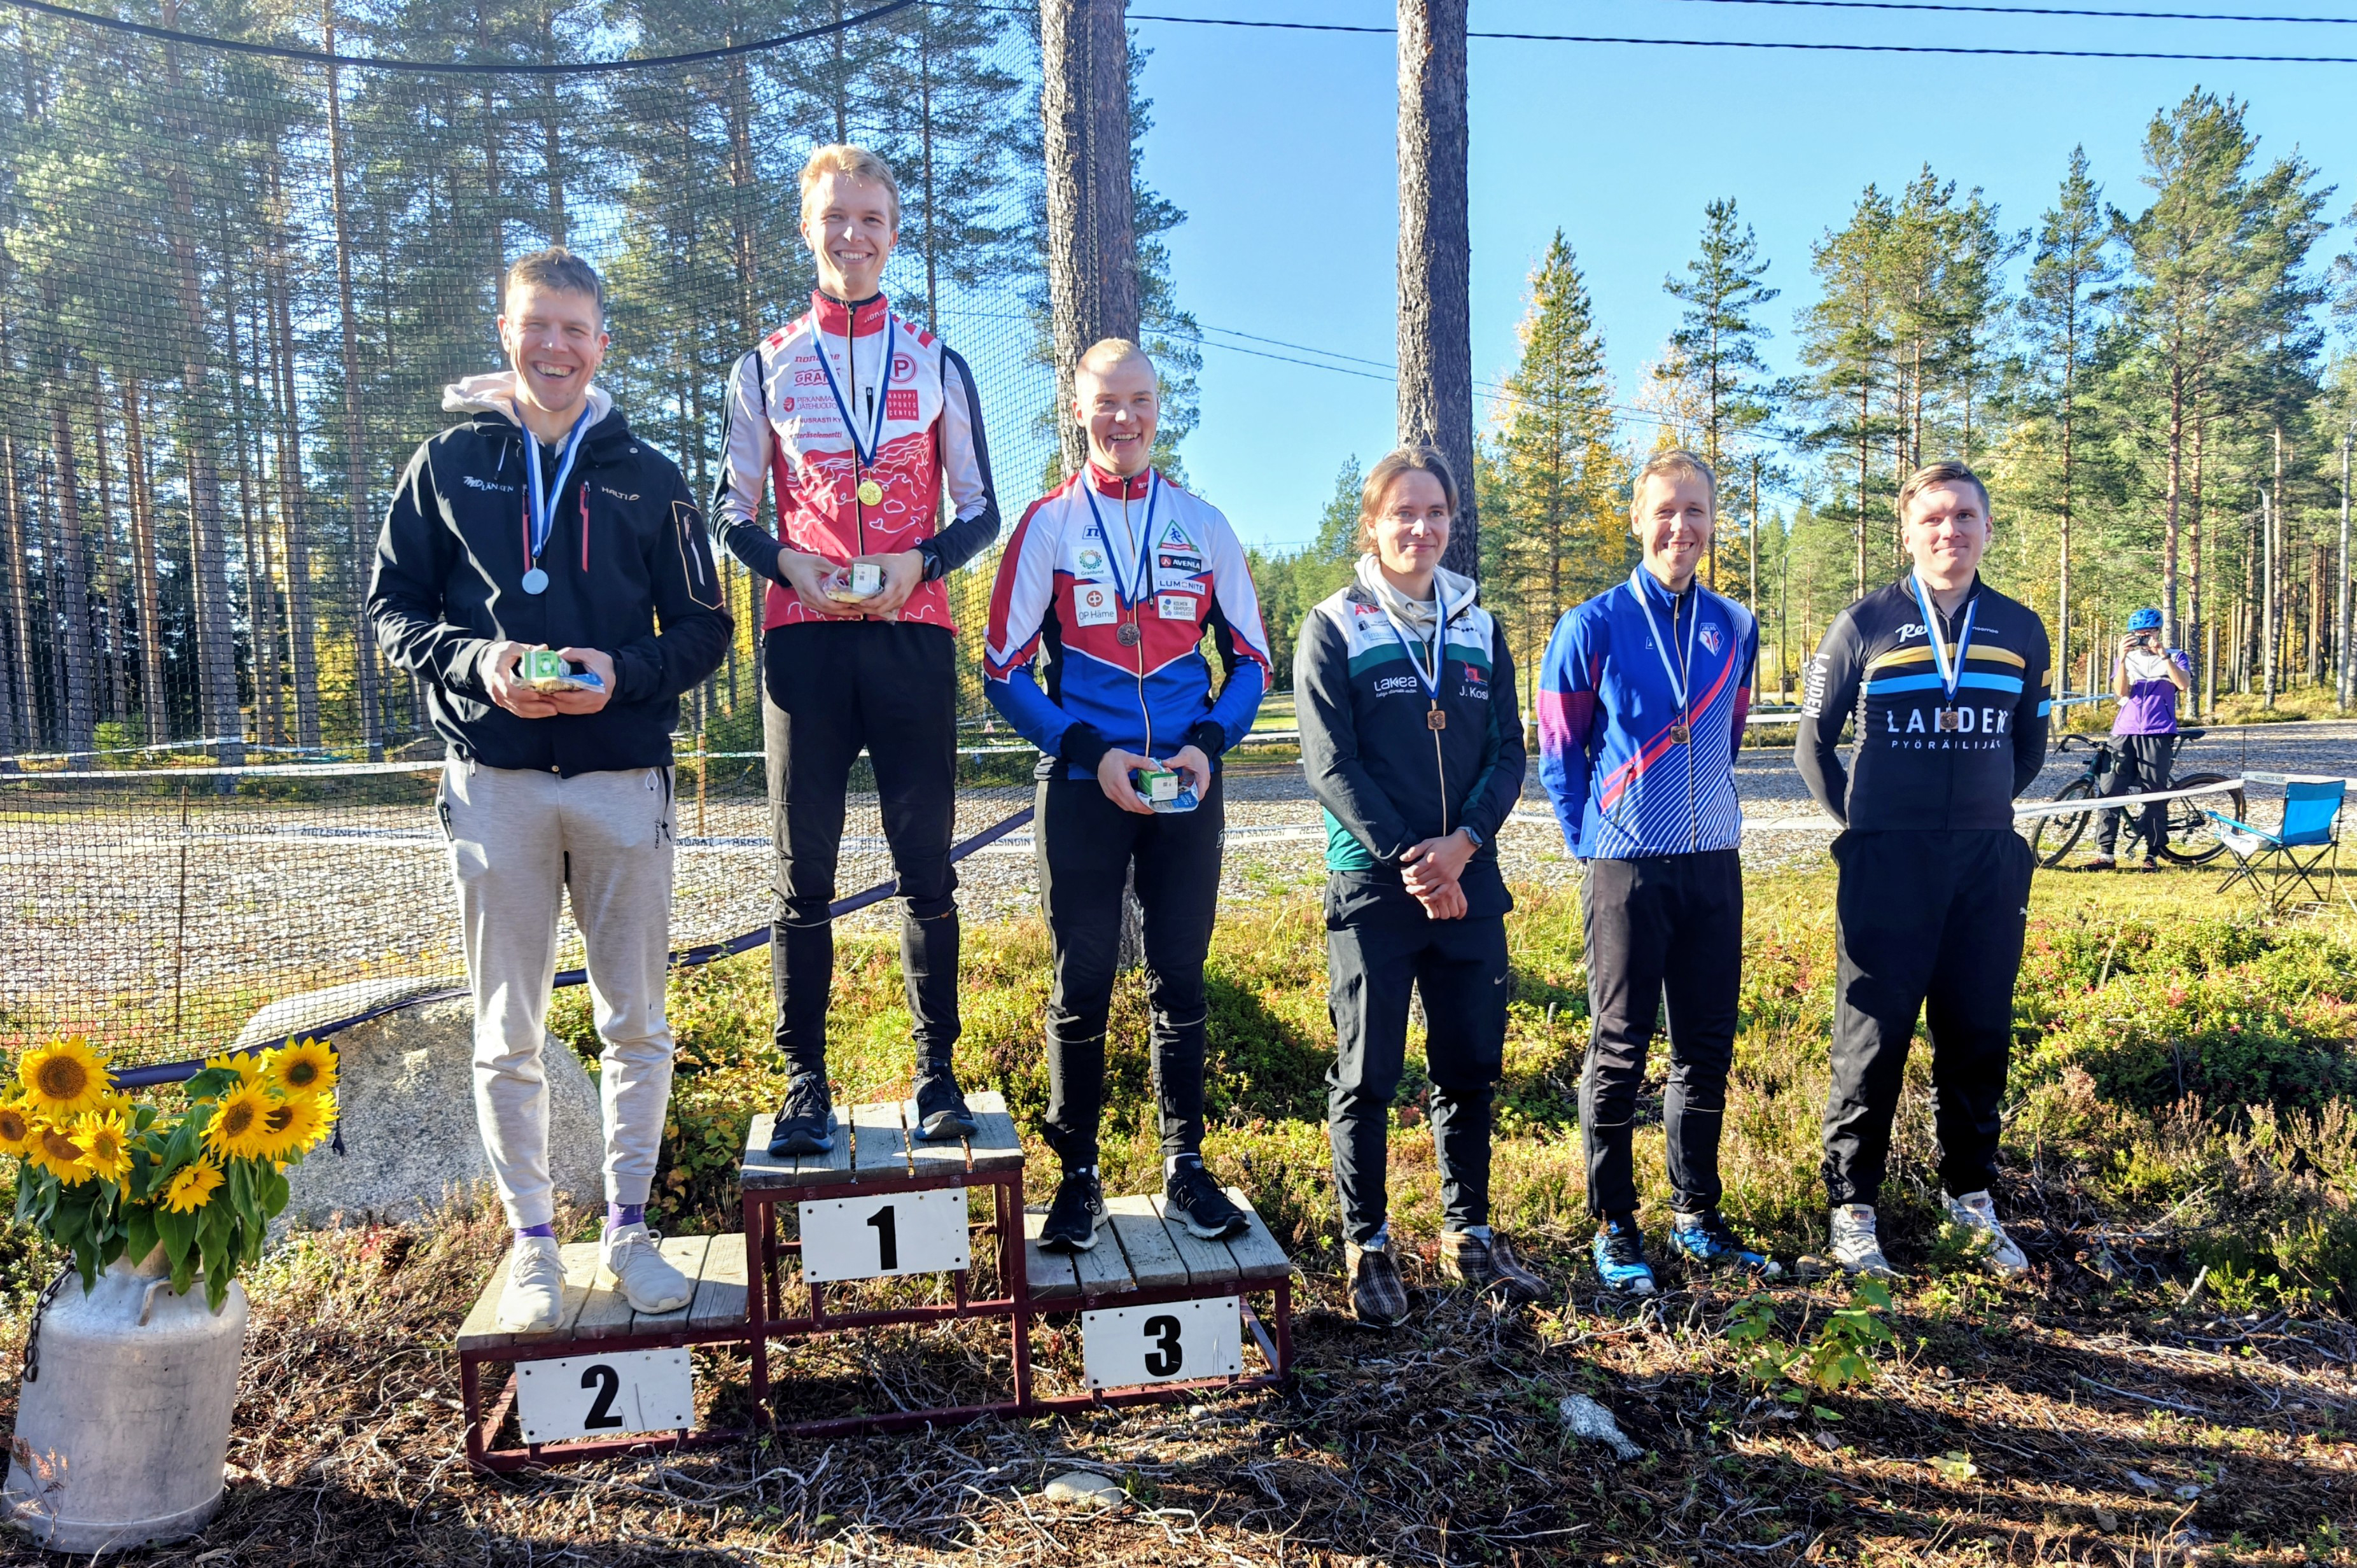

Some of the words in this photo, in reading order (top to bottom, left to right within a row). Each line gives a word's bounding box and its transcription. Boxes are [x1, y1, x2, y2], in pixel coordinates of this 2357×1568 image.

[893, 360, 909, 377] P
[602, 487, 627, 500] HALTI
[1079, 611, 1089, 620] OP
[1091, 610, 1114, 619] Häme
[1459, 685, 1468, 697] J.
[1805, 653, 1831, 718] LAHDEN
[1247, 827, 1286, 837] SANOMAT
[867, 1205, 897, 1271] 1
[1144, 1315, 1182, 1377] 3
[582, 1364, 623, 1430] 2
